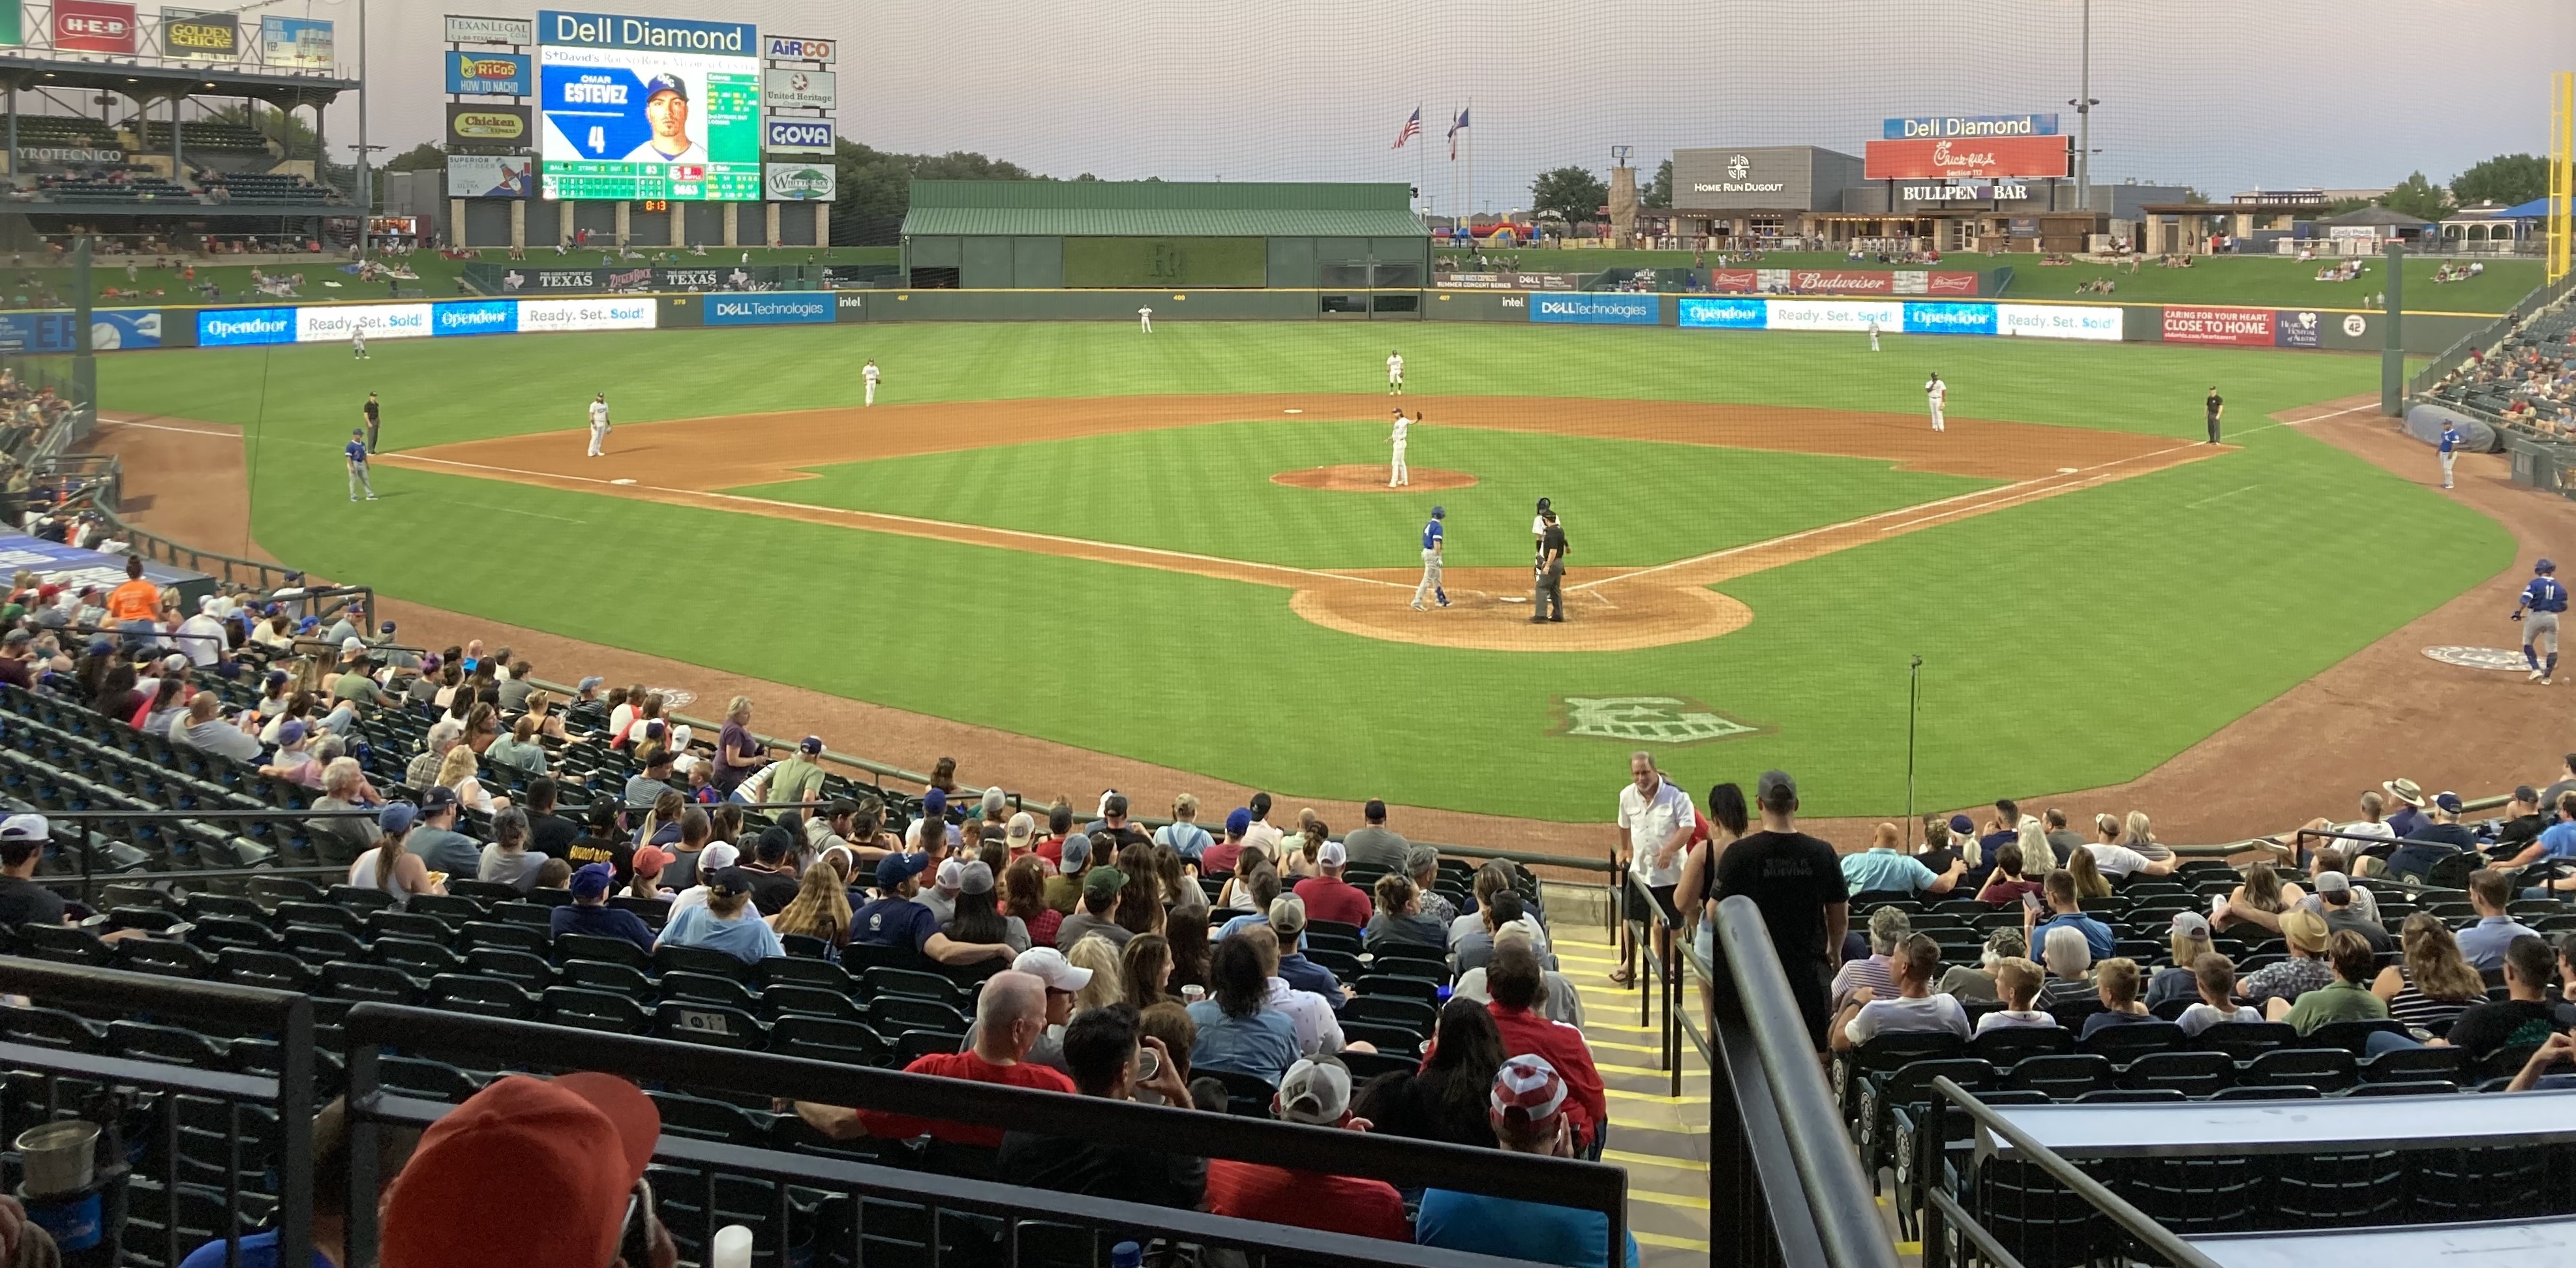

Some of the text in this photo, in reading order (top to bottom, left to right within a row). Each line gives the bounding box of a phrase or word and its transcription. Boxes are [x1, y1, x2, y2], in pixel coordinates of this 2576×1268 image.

[172, 23, 232, 38] GOLDEN
[557, 14, 742, 51] Dell Diamond
[177, 35, 226, 48] CHICK
[266, 42, 279, 52] YEP.
[580, 74, 612, 84] OMAR
[461, 80, 519, 93] HOW TO NACHO
[564, 82, 628, 104] ESTEVEZ
[796, 93, 832, 103] Heritage
[464, 116, 515, 127] Chicken
[1904, 116, 2031, 137] Dell Diamond
[588, 125, 605, 154] 4
[772, 125, 828, 144] GOYA
[17, 147, 121, 162] YROTECNICO
[1933, 143, 1996, 166] Chick-fil-A
[1694, 183, 1783, 192] HOME RUN DUGOUT
[1903, 185, 2027, 200] BULLPEN BAR
[645, 200, 666, 211] 0:13
[539, 275, 593, 287] TEXAS
[667, 274, 717, 285] TEXAS
[1519, 275, 1540, 284] DELL
[1798, 273, 1885, 290] Budweiser
[530, 308, 644, 322] Ready. Set. Sold!
[717, 302, 823, 316] DELL Technologies
[1541, 301, 1646, 318] DELL Technologies
[1778, 309, 1892, 323] Ready. Set. Sold!
[2165, 310, 2196, 320] CARING
[2239, 313, 2269, 322] HEART.
[309, 313, 422, 331] Ready. Set. Sold!
[1913, 310, 1990, 328] Opendoor
[2008, 314, 2050, 329] Ready.
[2053, 316, 2078, 328] Set.
[208, 317, 288, 338] Opendoor
[2164, 320, 2269, 335] CLOSE TO HOME.
[2348, 323, 2361, 333] 42
[1424, 524, 1431, 536] 4
[2545, 584, 2554, 600] 11
